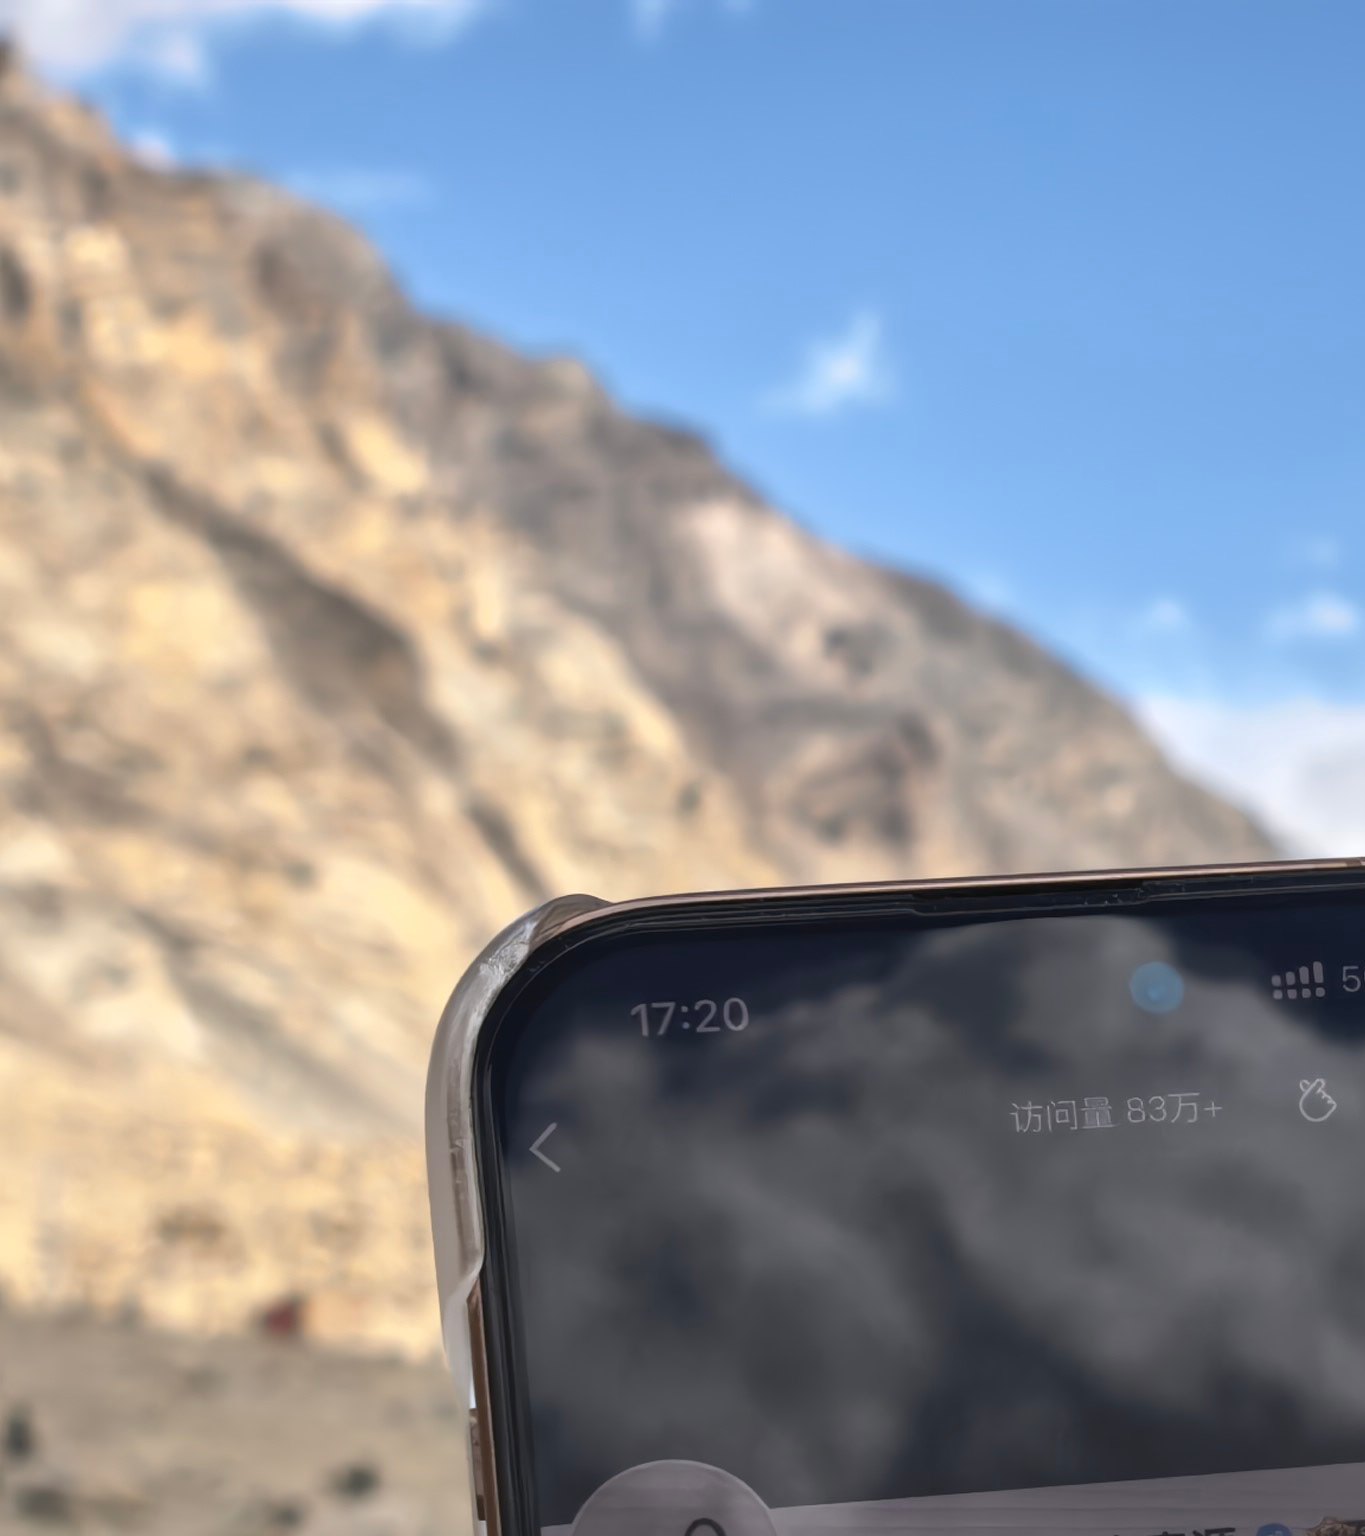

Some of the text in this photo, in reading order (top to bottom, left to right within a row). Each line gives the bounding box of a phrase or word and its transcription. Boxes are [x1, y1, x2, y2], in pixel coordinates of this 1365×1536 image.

[630, 997, 749, 1037] 17:20
[1009, 1092, 1223, 1133] 访问量 83万+
